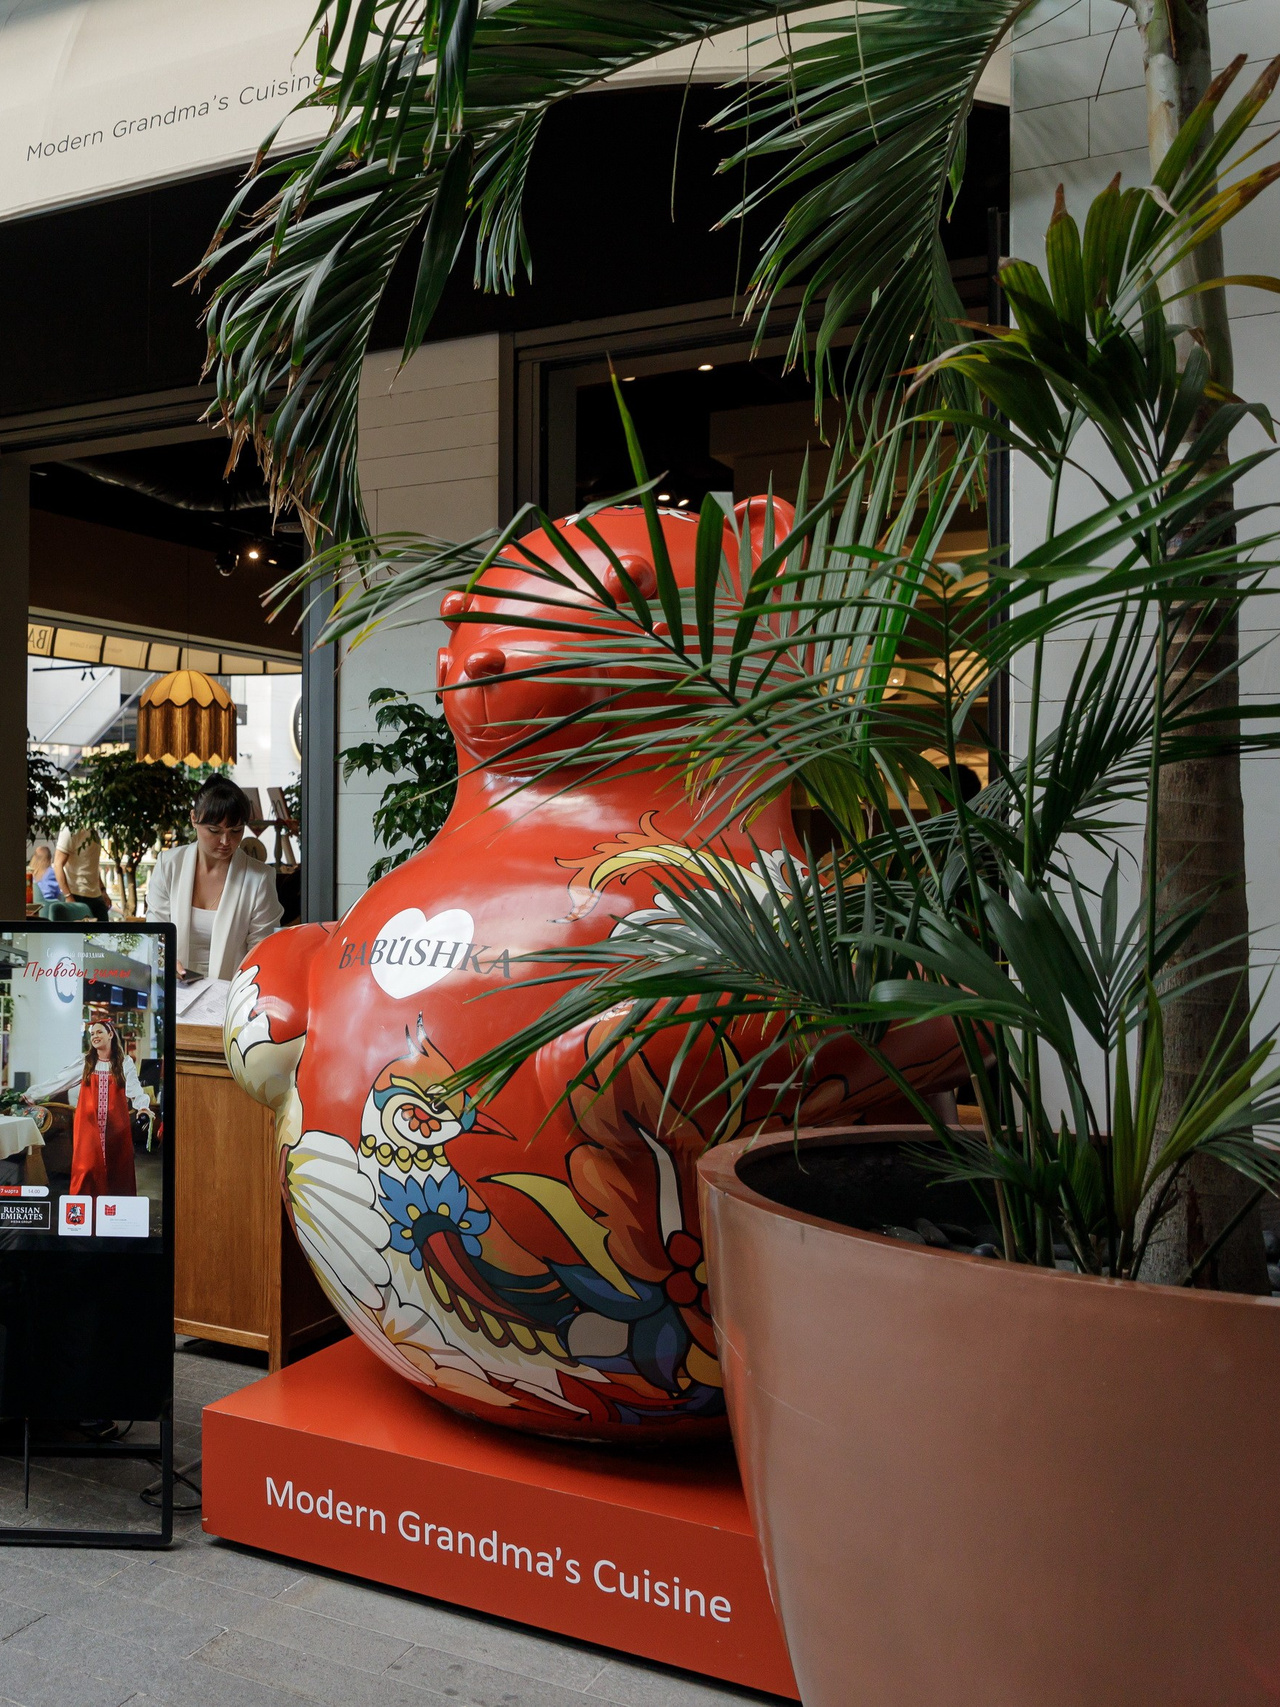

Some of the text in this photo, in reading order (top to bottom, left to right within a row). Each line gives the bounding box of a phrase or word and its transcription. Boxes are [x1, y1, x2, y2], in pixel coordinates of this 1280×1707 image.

[26, 73, 322, 161] Modern Grandma's Cuisine
[23, 961, 132, 985] Проводы зимы
[0, 1213, 43, 1221] EMIRATES
[3, 1206, 41, 1214] RUSSIAN
[265, 1476, 732, 1623] Modern Grandma's Cuisine
